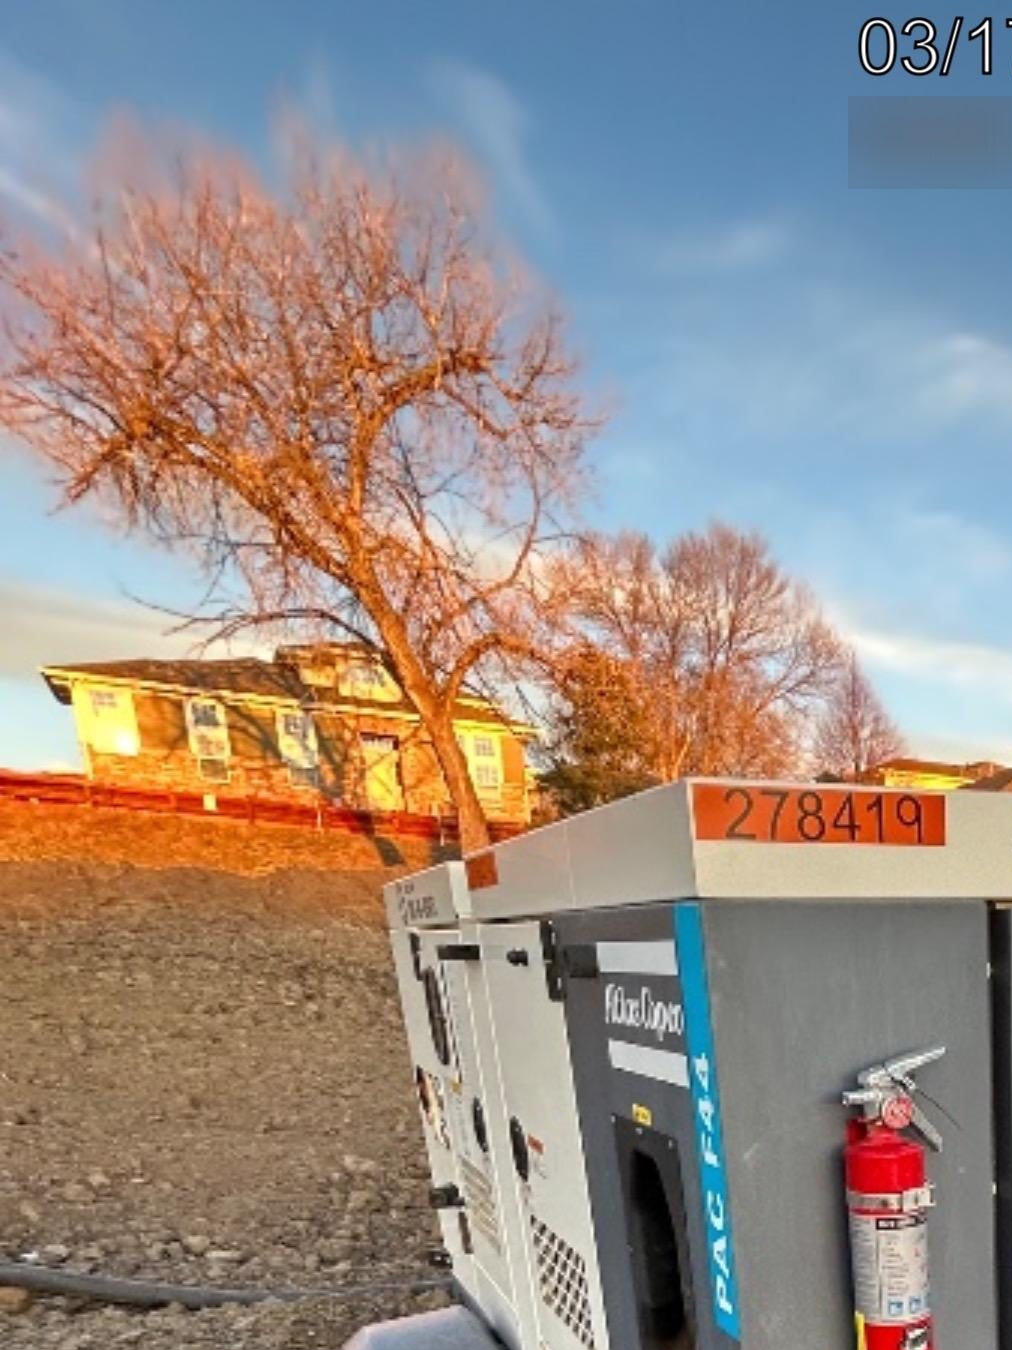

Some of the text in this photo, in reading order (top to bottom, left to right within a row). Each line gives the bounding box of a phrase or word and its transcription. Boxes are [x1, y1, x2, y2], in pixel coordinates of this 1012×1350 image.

[723, 788, 925, 843] 278419
[694, 1052, 733, 1315] PAC F44
